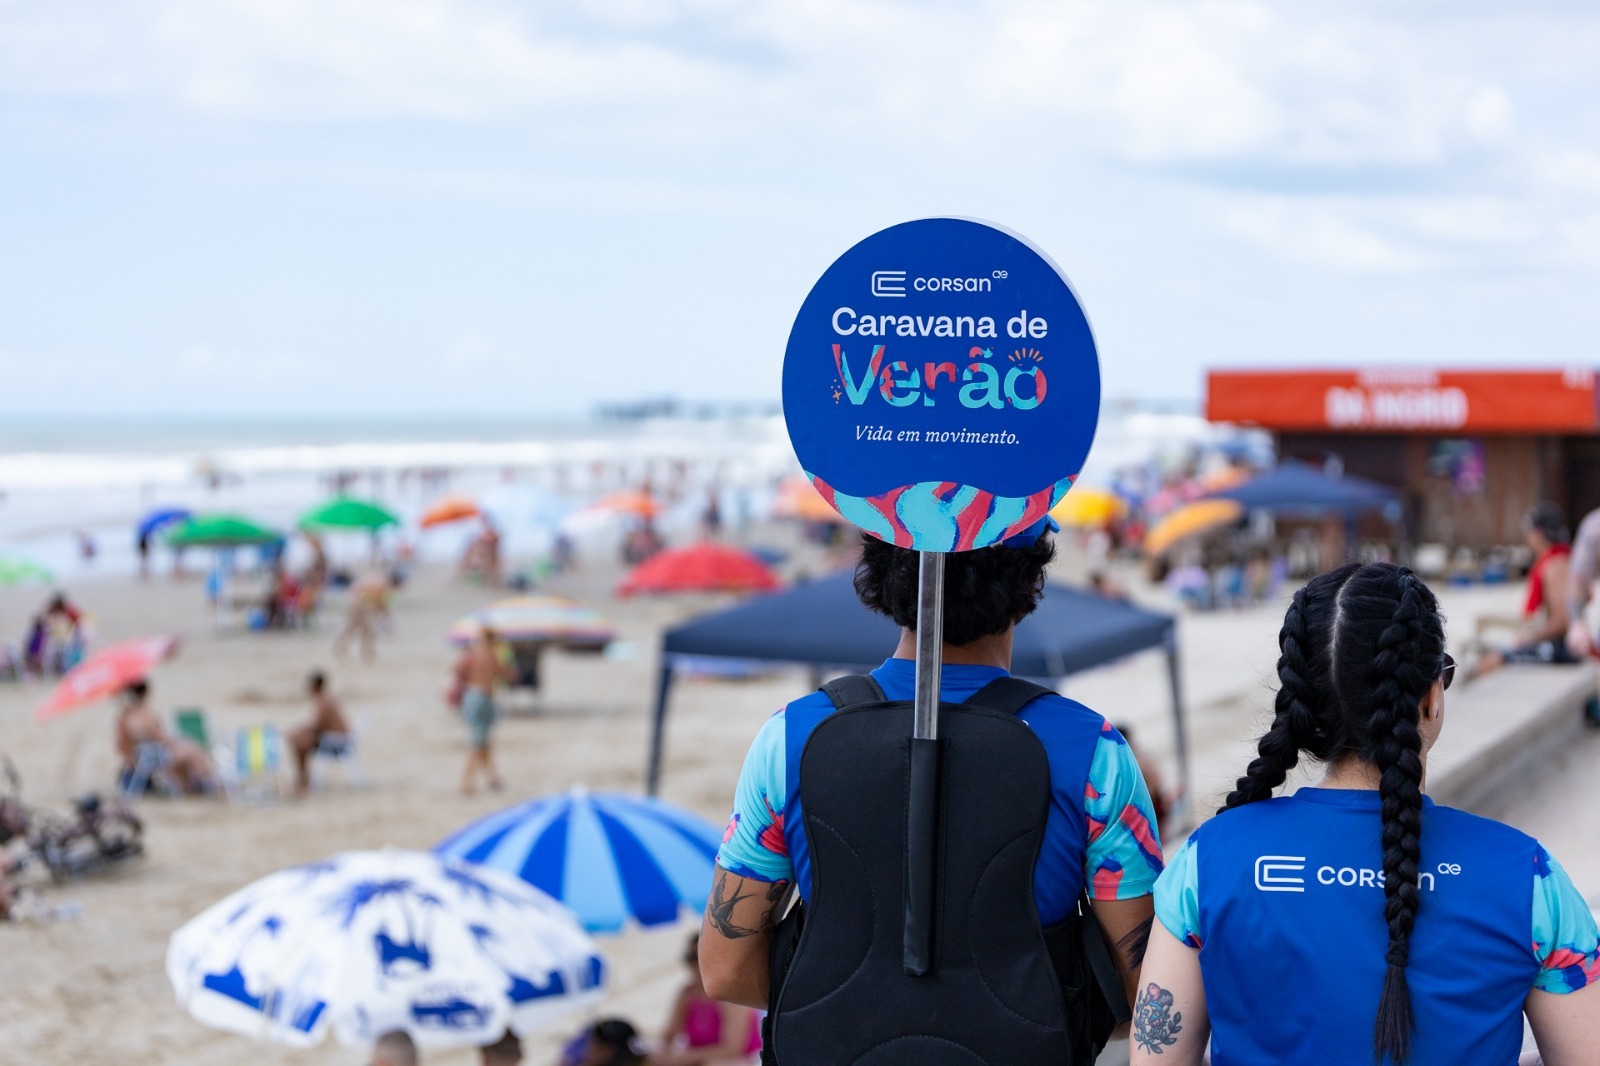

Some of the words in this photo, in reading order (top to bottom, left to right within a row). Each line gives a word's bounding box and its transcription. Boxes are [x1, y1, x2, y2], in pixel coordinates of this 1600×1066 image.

[831, 306, 997, 338] Caravana
[1006, 309, 1048, 339] de
[831, 343, 1048, 410] Verão
[854, 425, 893, 442] Vida
[896, 429, 920, 443] em
[925, 428, 1020, 445] movimento.
